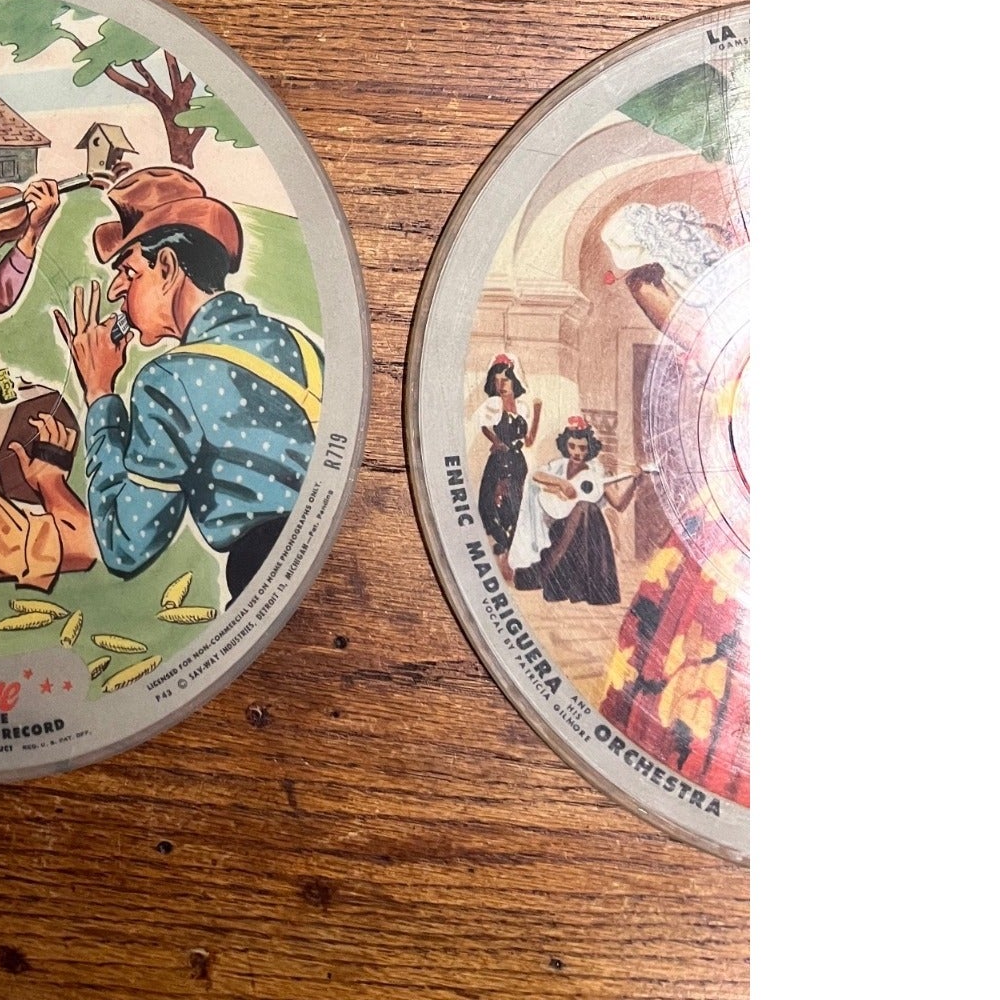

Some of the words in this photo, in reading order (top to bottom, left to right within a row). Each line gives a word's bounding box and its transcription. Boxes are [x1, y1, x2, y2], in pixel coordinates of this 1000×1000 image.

[706, 25, 736, 45] LA
[323, 433, 348, 471] R719
[444, 455, 475, 527] ENRIC
[146, 669, 179, 691] LICENSED
[179, 657, 193, 670] FOR
[192, 608, 248, 659] NON-COMMERCIAL
[247, 596, 260, 608] USE
[260, 583, 269, 596] ON
[267, 562, 283, 583] HOME
[280, 504, 312, 561] PHONOGRAPHS
[189, 653, 220, 680] SAV-WAY
[255, 592, 279, 621] DETROIT
[317, 490, 334, 520] Pending
[466, 540, 562, 696] MADRIGUERA
[482, 598, 505, 634] VOCAL
[503, 638, 515, 650] BY
[514, 655, 550, 700] PATRICIA
[553, 704, 591, 743] GILMORE
[571, 695, 591, 715] AND
[1, 719, 65, 740] RECORD
[566, 704, 582, 720] HIS
[594, 724, 721, 818] ORCHESTRA
